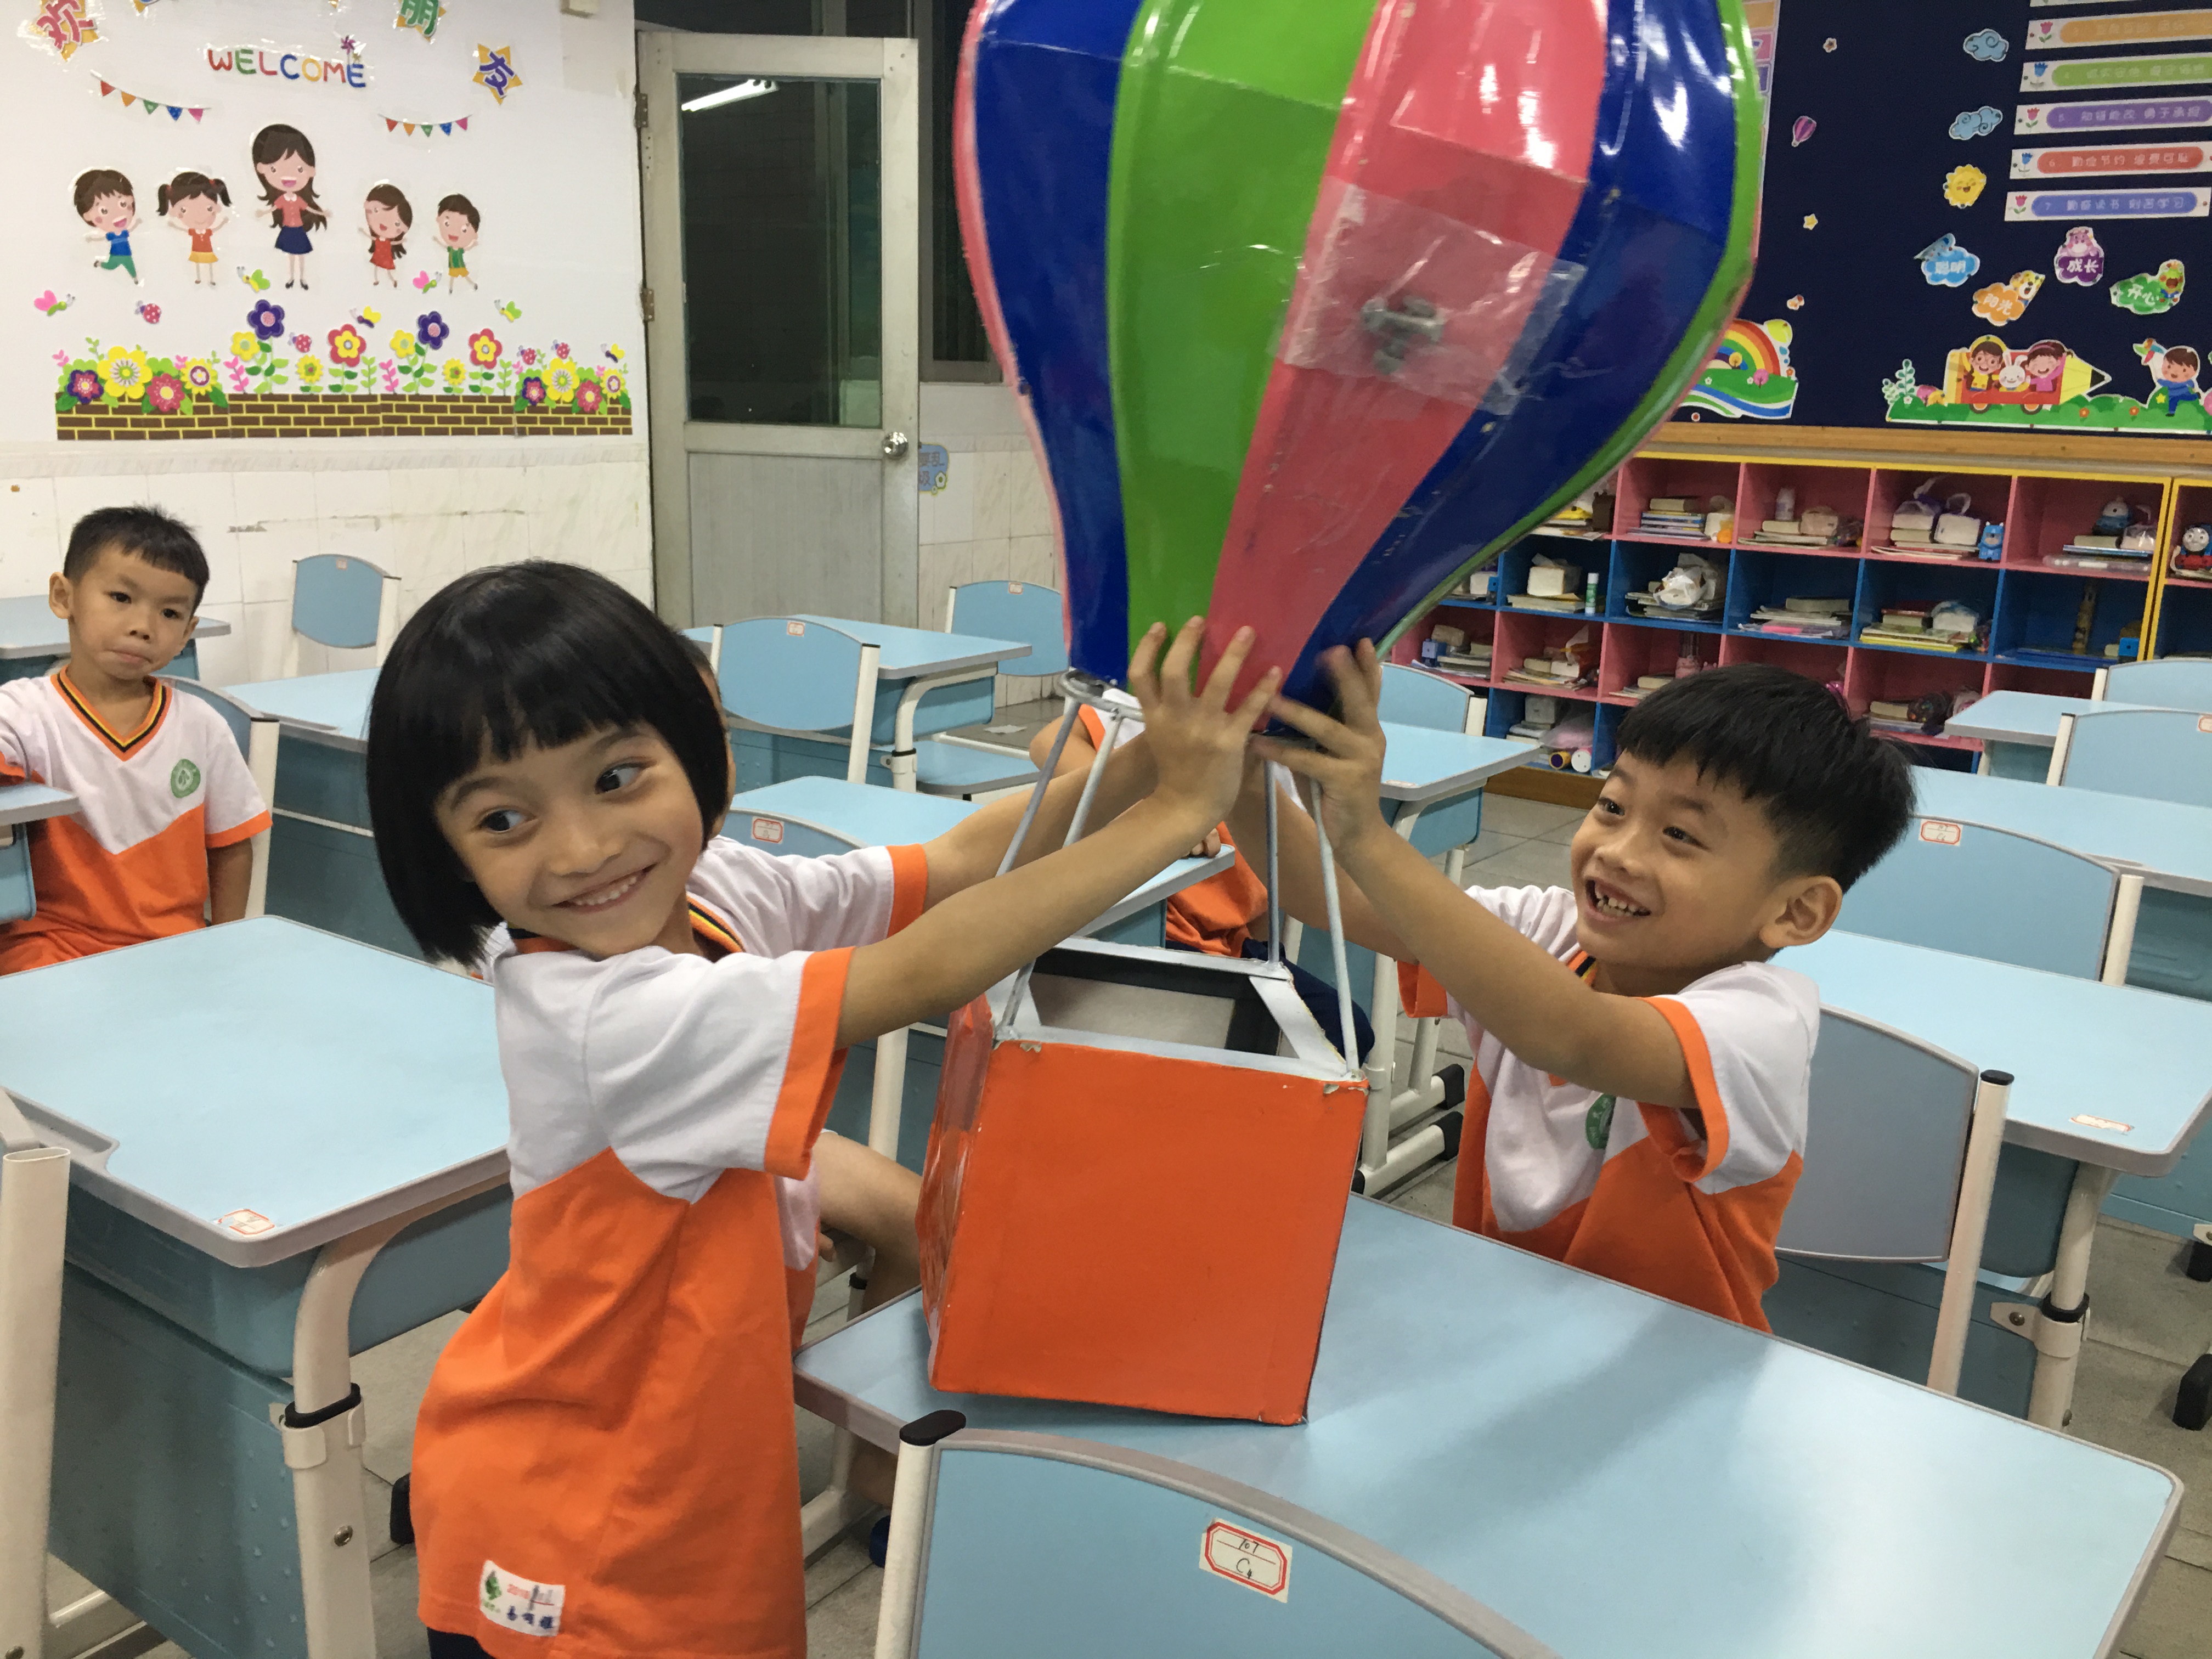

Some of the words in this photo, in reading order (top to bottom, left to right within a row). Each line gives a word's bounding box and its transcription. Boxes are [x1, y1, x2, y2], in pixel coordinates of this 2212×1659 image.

[207, 48, 366, 88] WELCOME
[479, 51, 515, 96] 友
[1934, 259, 1966, 275] 聪明
[2066, 258, 2099, 273] 成长
[1982, 292, 2013, 316] 阳光
[2126, 283, 2160, 306] 开心
